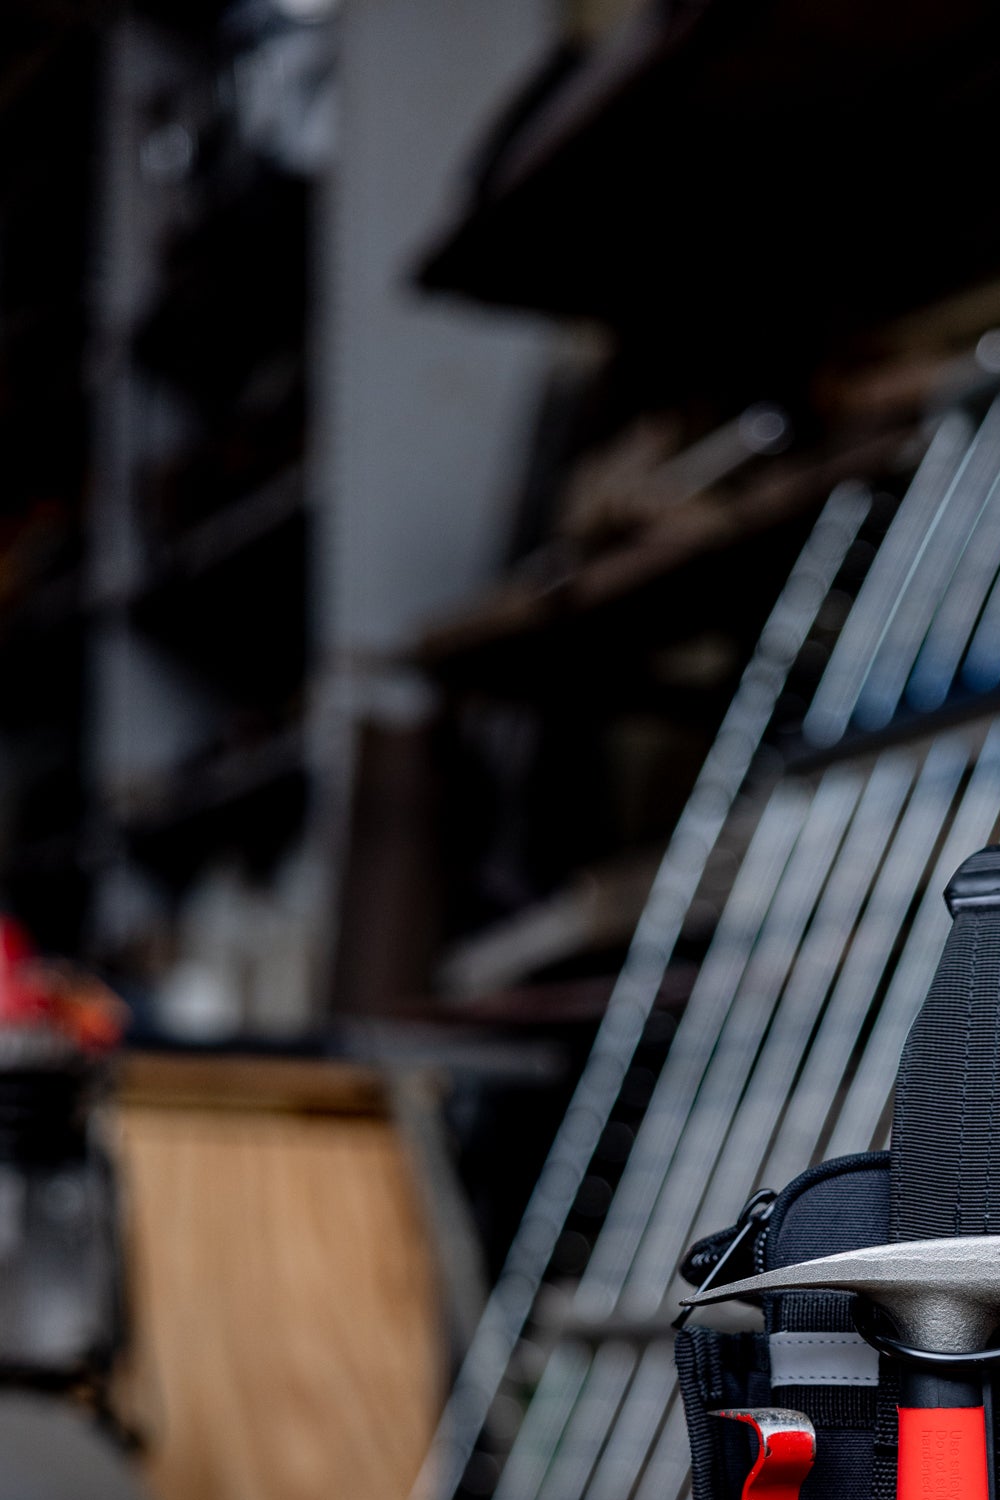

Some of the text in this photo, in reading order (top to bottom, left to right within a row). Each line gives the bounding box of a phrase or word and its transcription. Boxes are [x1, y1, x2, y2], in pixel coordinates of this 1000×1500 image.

[935, 1430, 948, 1448] Do
[949, 1430, 963, 1456] Use
[920, 1430, 934, 1493] hardened
[935, 1453, 948, 1475] not
[946, 1460, 963, 1500] safety
